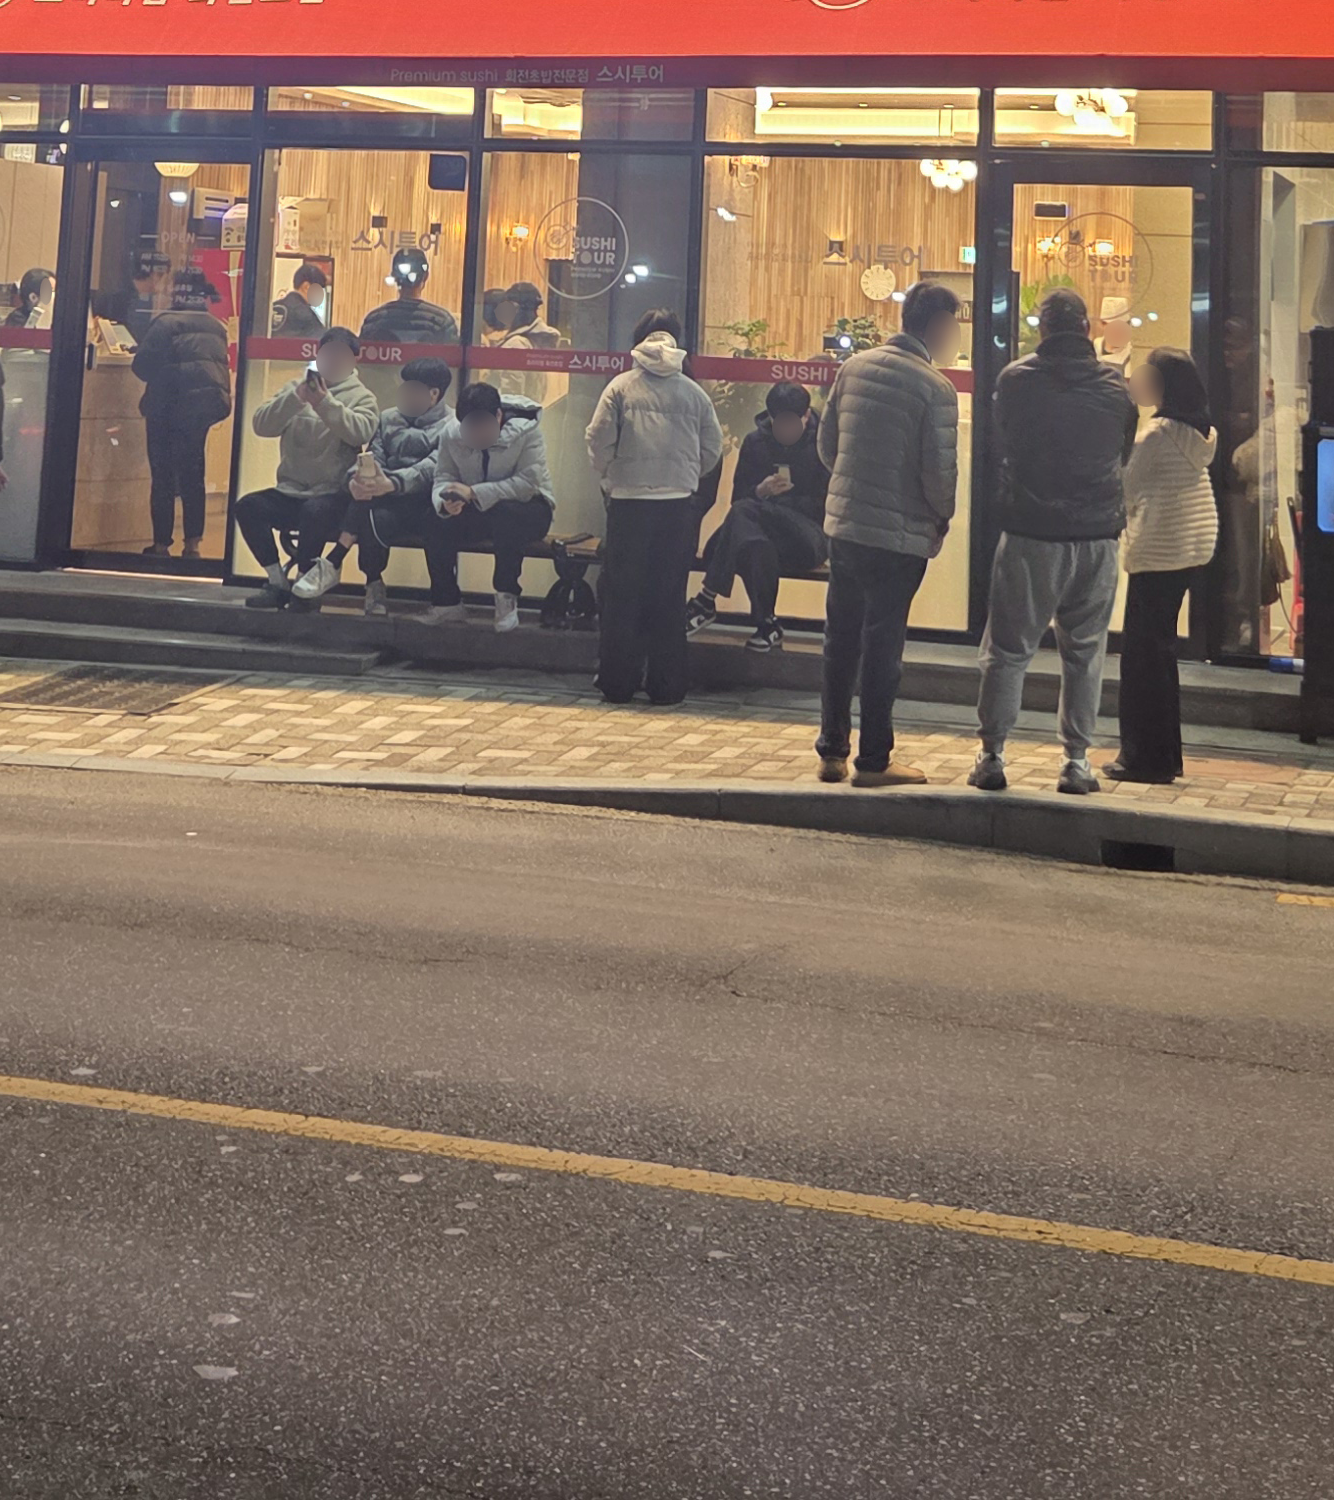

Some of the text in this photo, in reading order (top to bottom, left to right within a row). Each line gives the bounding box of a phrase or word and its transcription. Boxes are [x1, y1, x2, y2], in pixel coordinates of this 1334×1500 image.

[390, 64, 664, 84] Premium sushi 회전초밥전문점 스시투어
[161, 232, 195, 243] OPEN
[572, 236, 617, 251] SUSHI
[823, 243, 924, 270] 스시투어
[568, 355, 625, 371] 스시투어
[771, 365, 828, 381] SUSHI
